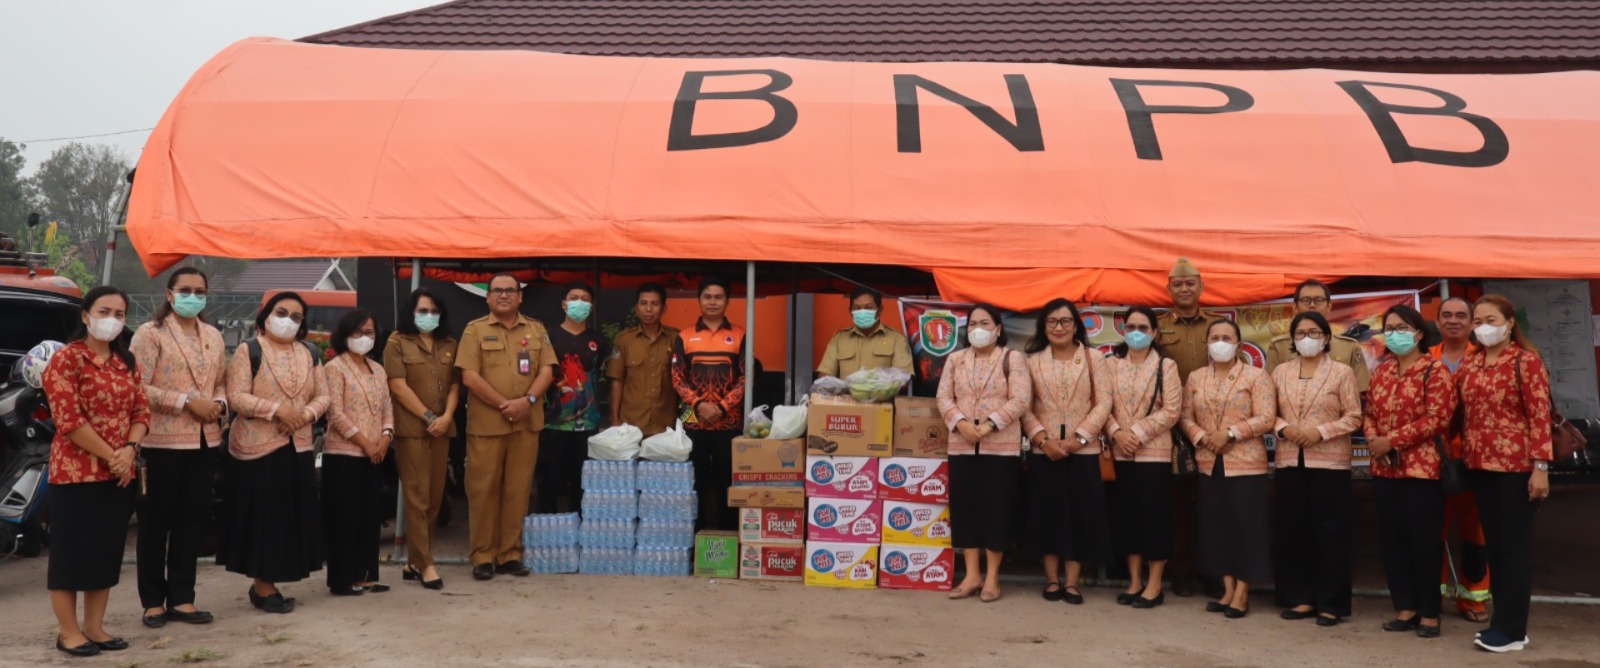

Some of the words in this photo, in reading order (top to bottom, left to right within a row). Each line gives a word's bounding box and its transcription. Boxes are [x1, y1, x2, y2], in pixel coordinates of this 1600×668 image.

[666, 68, 1509, 166] BNPB
[828, 423, 858, 431] BUBUR
[768, 519, 797, 531] pucuk
[768, 557, 796, 568] pucuk
